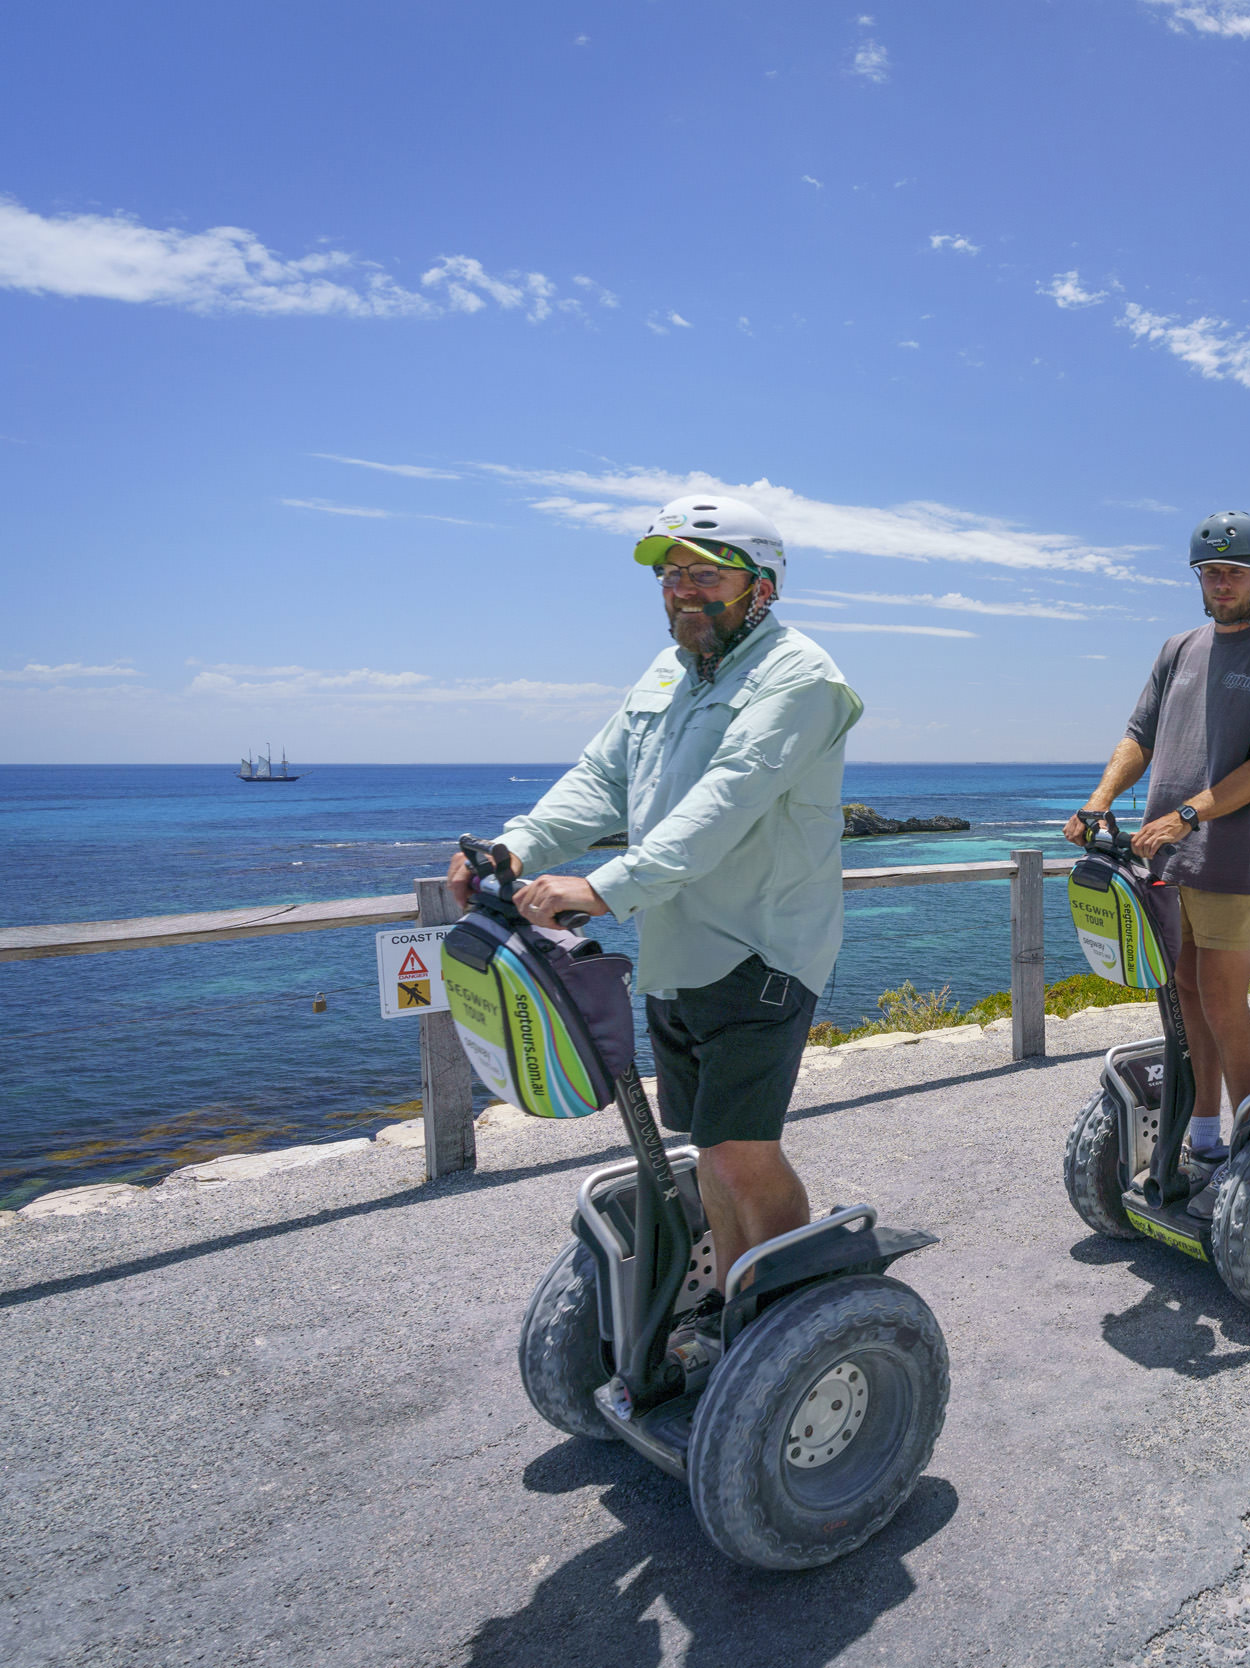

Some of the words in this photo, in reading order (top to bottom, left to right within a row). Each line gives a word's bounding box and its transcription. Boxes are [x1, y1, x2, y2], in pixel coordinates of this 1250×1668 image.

[1071, 899, 1116, 920] SEGWAY
[1085, 913, 1105, 928] TOUR
[391, 932, 432, 945] COAST
[1122, 903, 1135, 973] segtours.com.au
[398, 973, 429, 981] DANGER
[446, 979, 499, 1017] SEGWAY
[463, 1003, 487, 1025] TOUR
[514, 994, 545, 1096] segtours.com.au
[620, 1062, 674, 1183] SEGWAY
